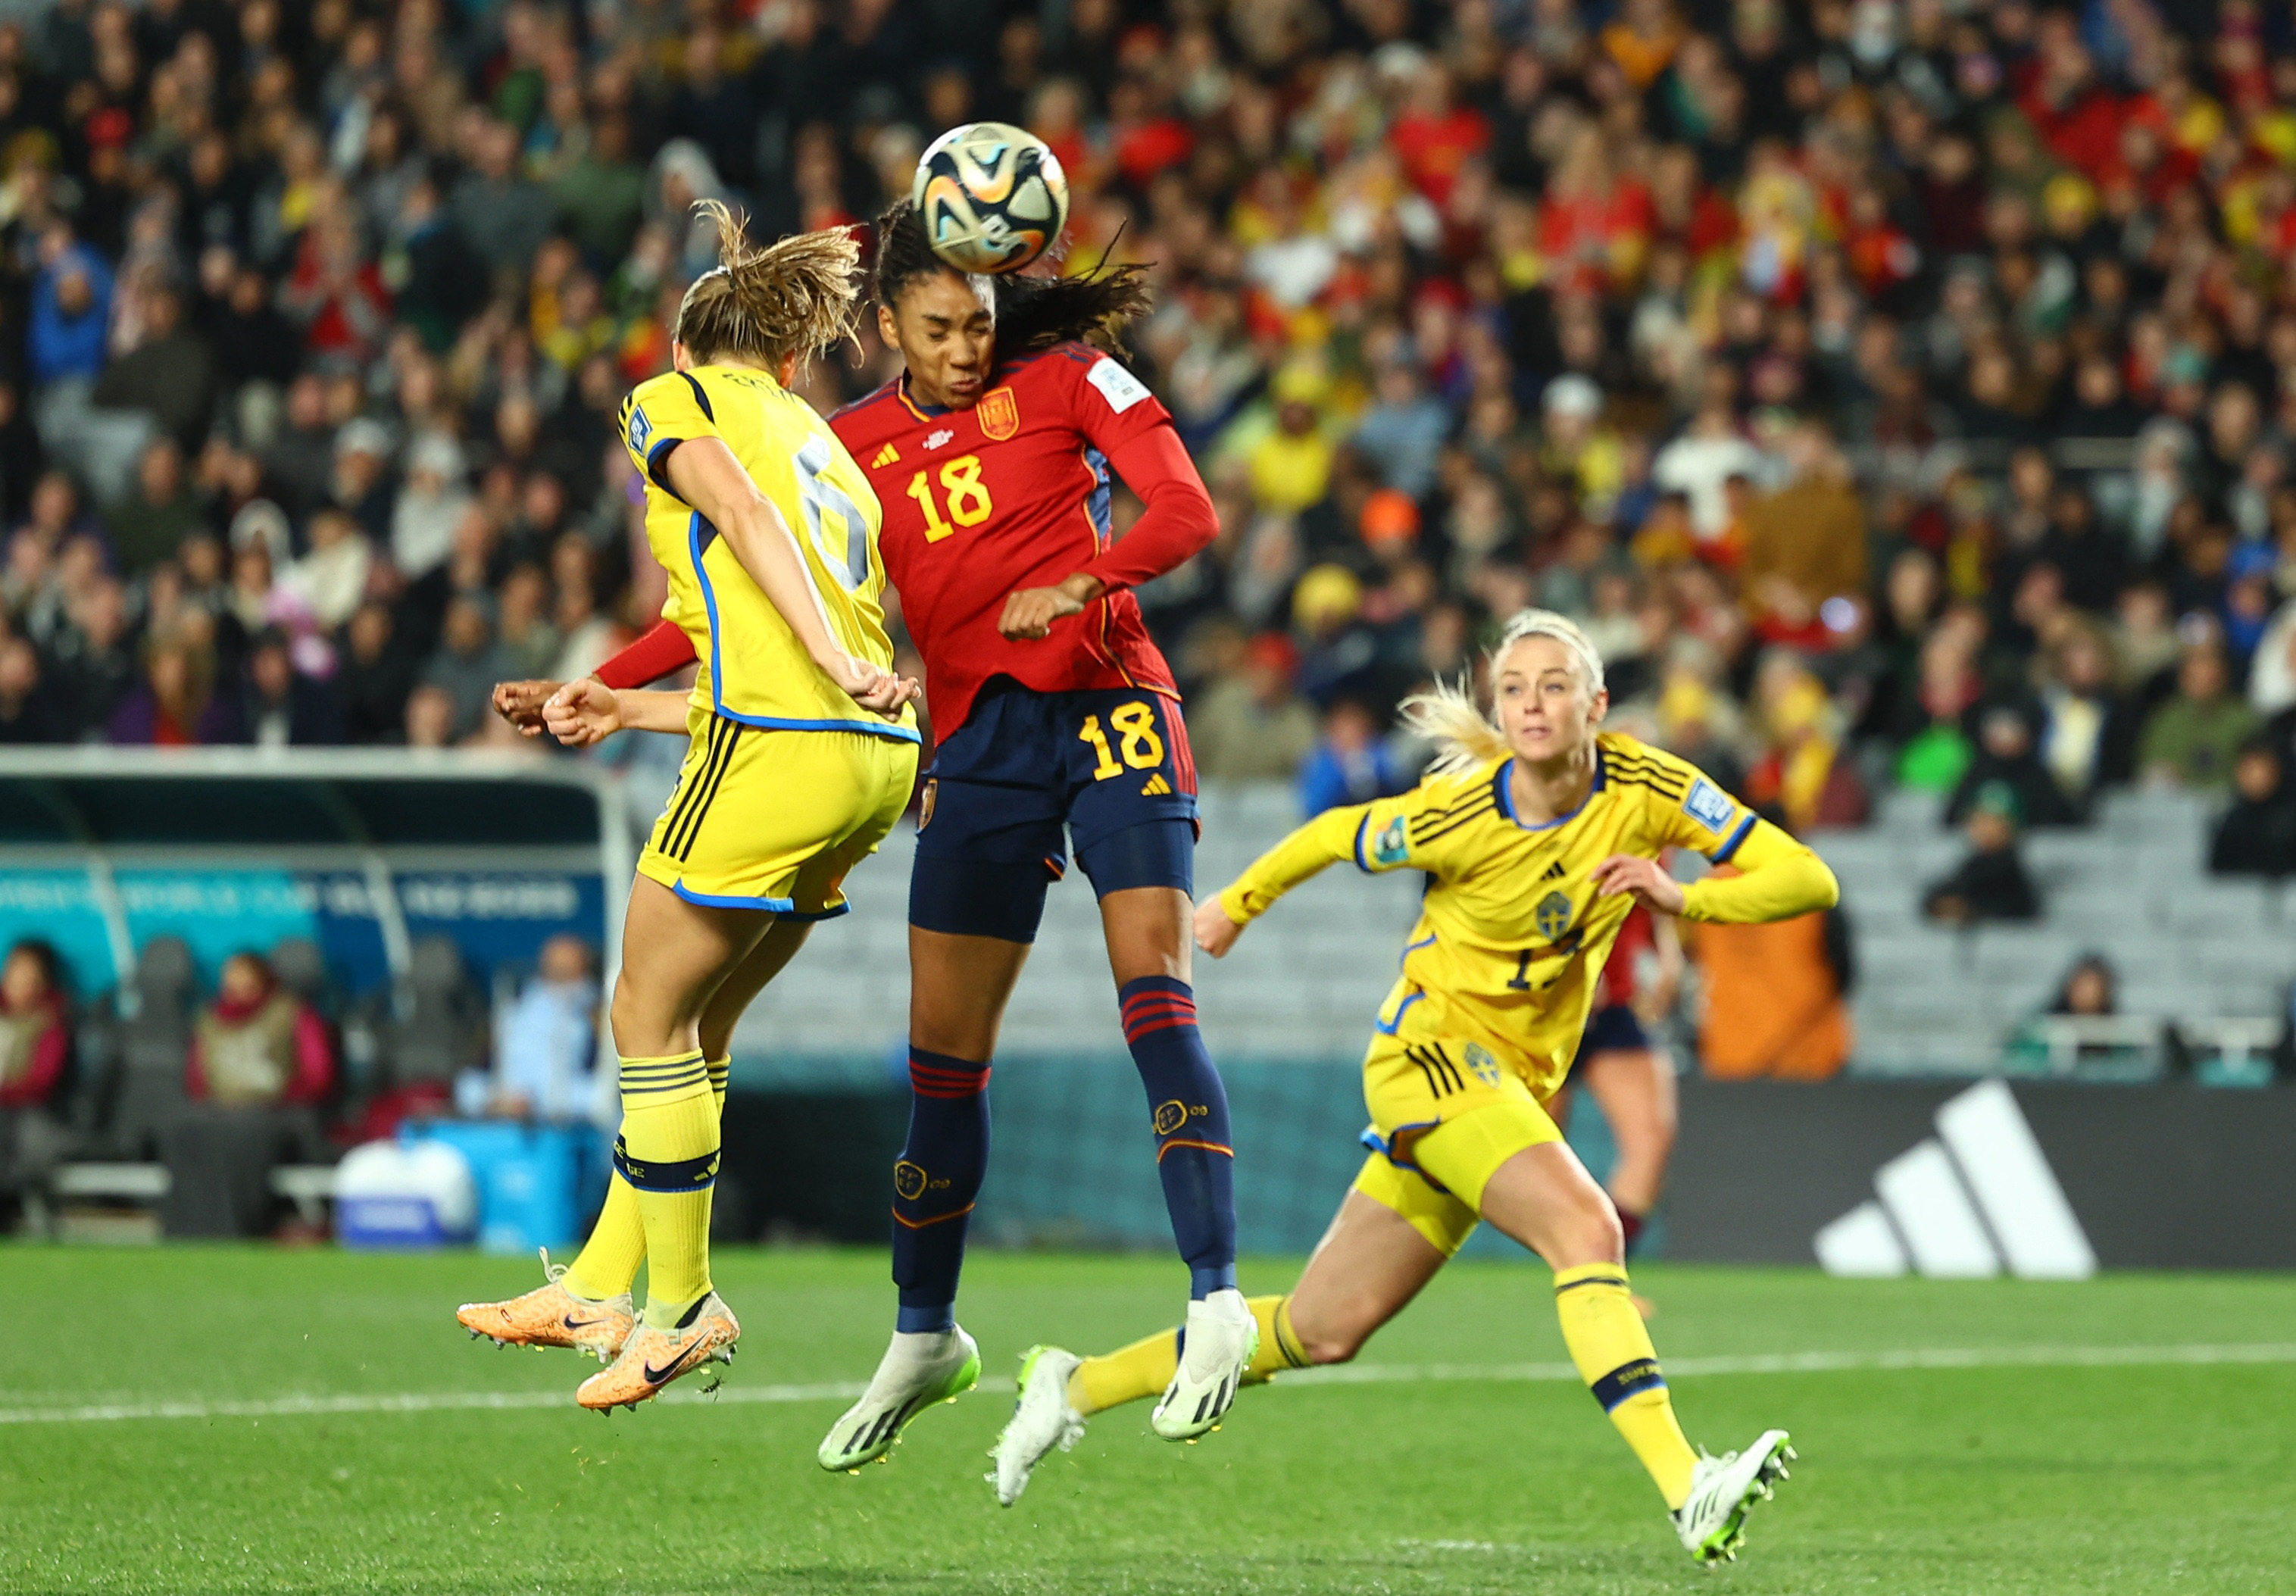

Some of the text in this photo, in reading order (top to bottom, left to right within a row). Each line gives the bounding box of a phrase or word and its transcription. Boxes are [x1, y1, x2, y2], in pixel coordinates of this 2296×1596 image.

[792, 431, 869, 593] 6
[906, 454, 993, 544] 18
[1079, 700, 1164, 781] 18
